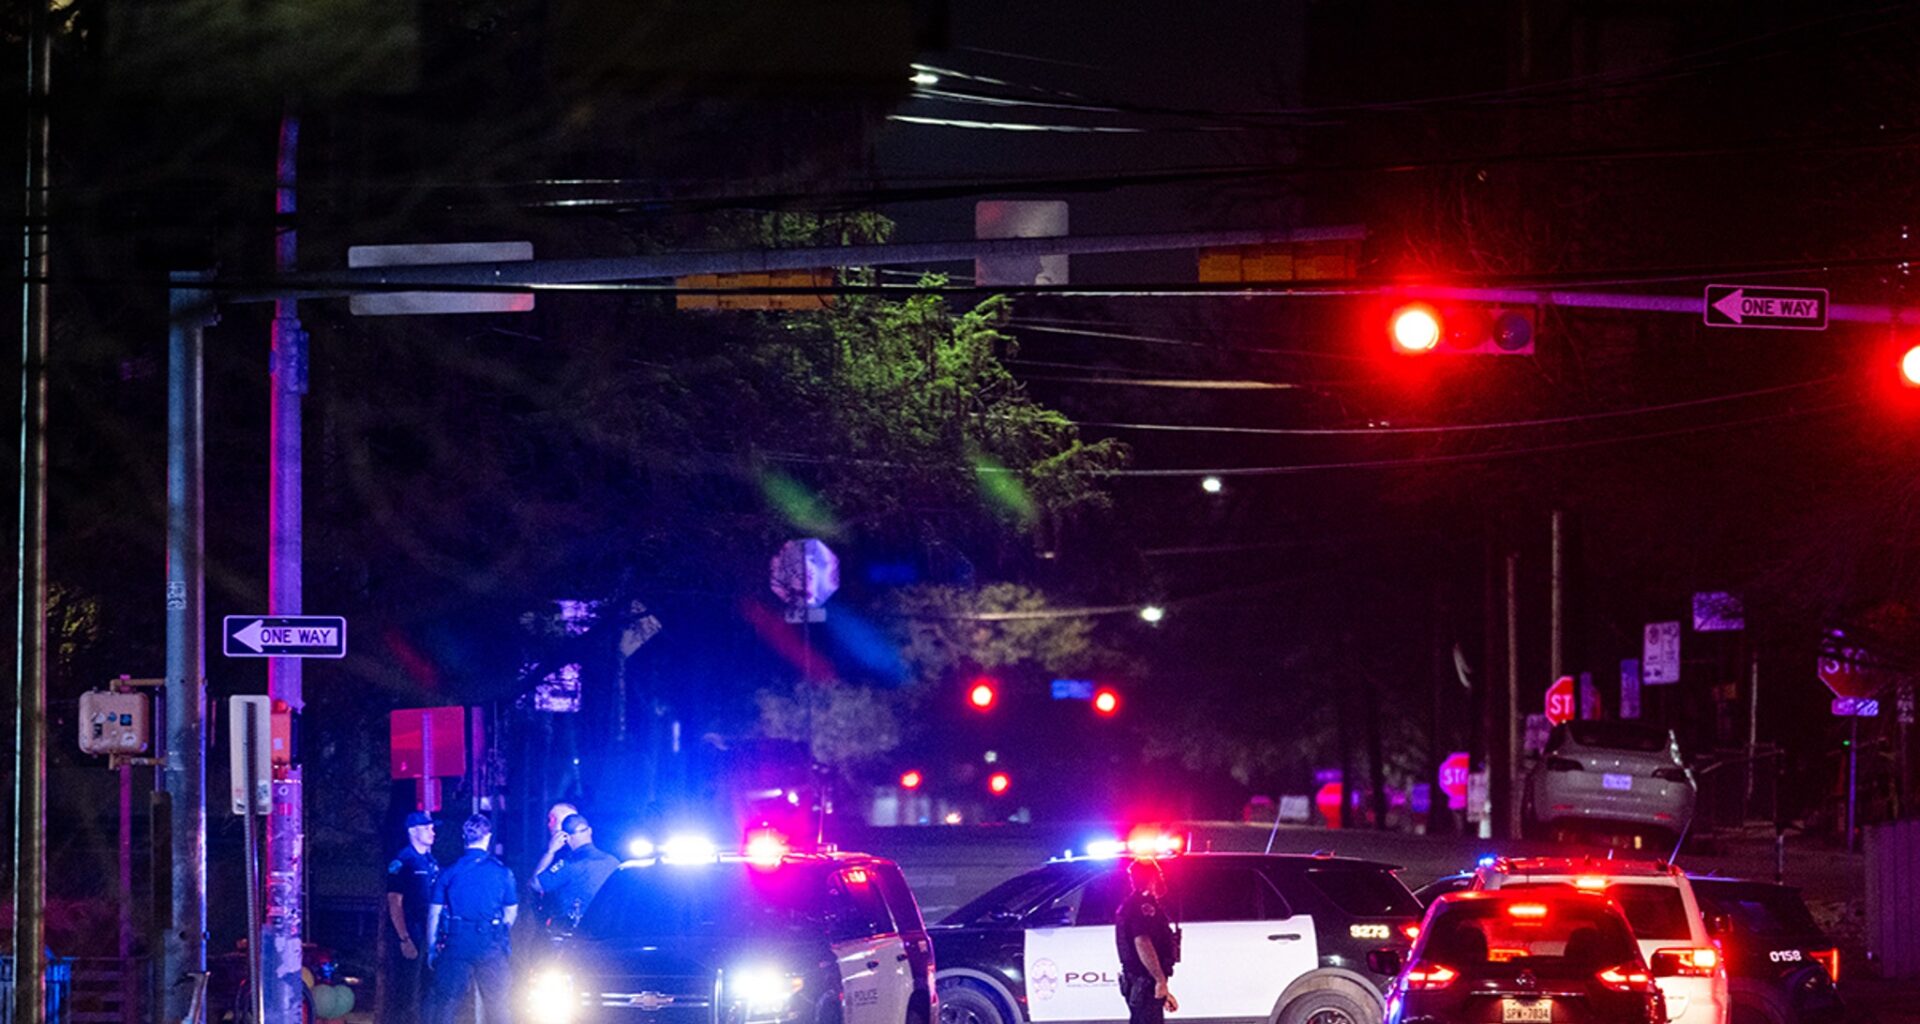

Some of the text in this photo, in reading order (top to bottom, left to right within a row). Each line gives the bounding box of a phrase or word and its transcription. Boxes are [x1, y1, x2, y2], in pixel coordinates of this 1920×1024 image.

[1742, 299, 1815, 317] ONE WAY
[261, 629, 331, 644] ONE WAY
[1769, 949, 1802, 963] 0158
